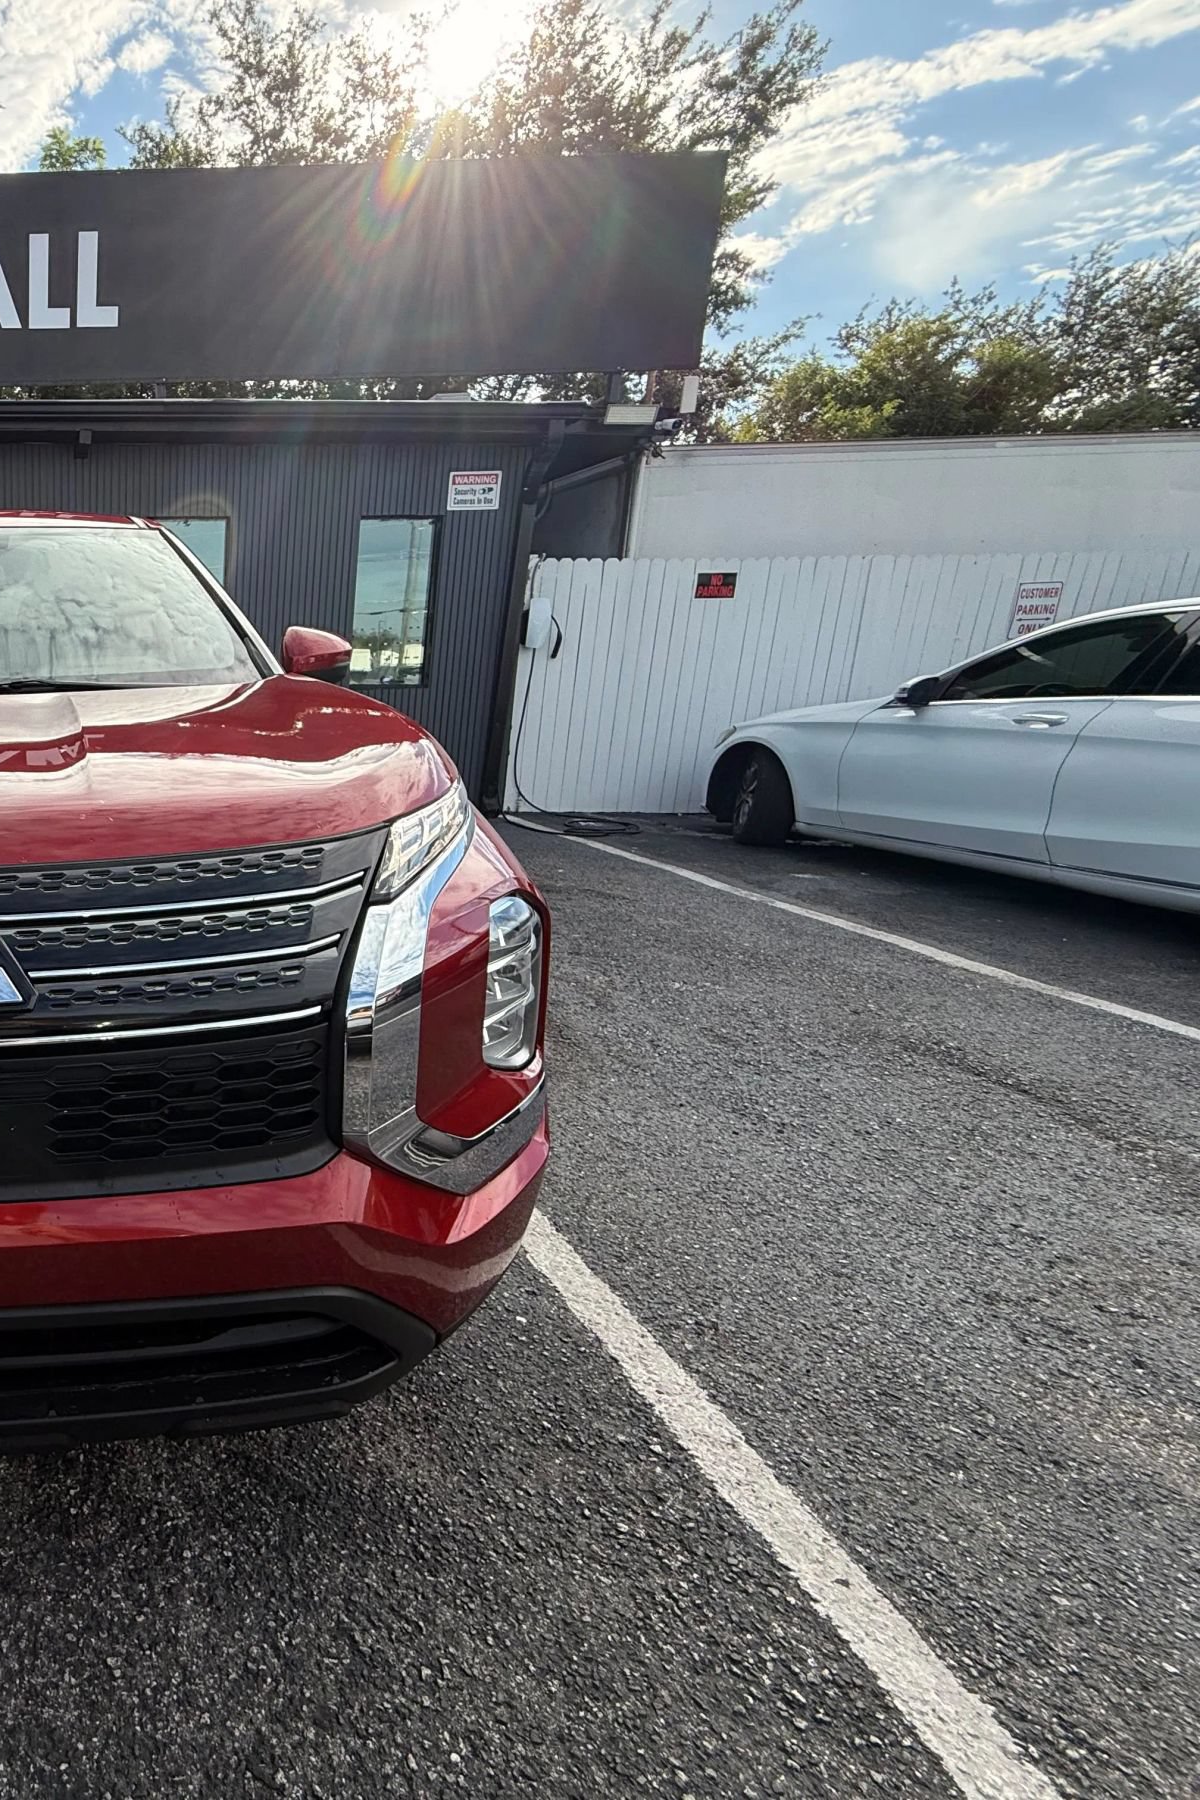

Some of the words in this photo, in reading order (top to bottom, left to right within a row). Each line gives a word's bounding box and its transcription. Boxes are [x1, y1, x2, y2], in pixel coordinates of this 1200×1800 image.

[454, 474, 497, 484] WARNING
[454, 488, 477, 496] Security
[453, 497, 476, 505] Cameras
[710, 574, 723, 586] NO
[696, 585, 734, 597] PARKING
[1020, 587, 1060, 599] CUSTOMER
[1016, 604, 1056, 615] PARKING
